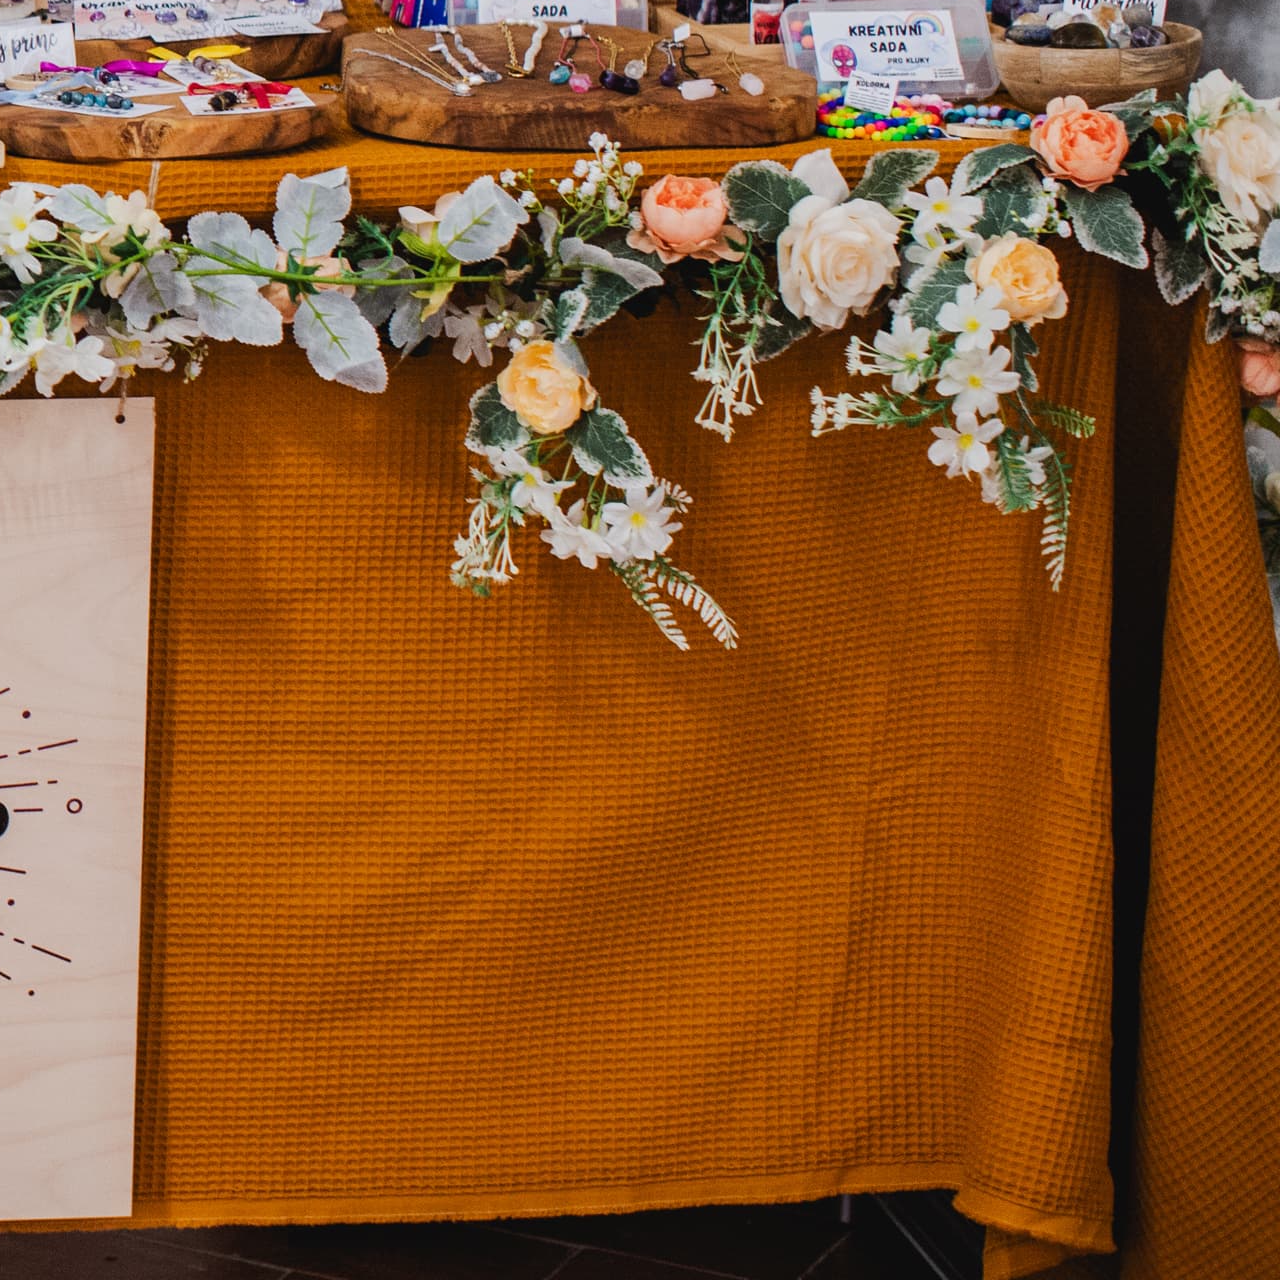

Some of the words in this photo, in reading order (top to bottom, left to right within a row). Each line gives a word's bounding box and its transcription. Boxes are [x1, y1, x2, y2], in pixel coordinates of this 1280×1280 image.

[532, 5, 568, 17] SADA
[11, 32, 58, 60] princ
[870, 41, 908, 53] SADA
[888, 57, 903, 65] PRO
[906, 57, 930, 65] KLUKY
